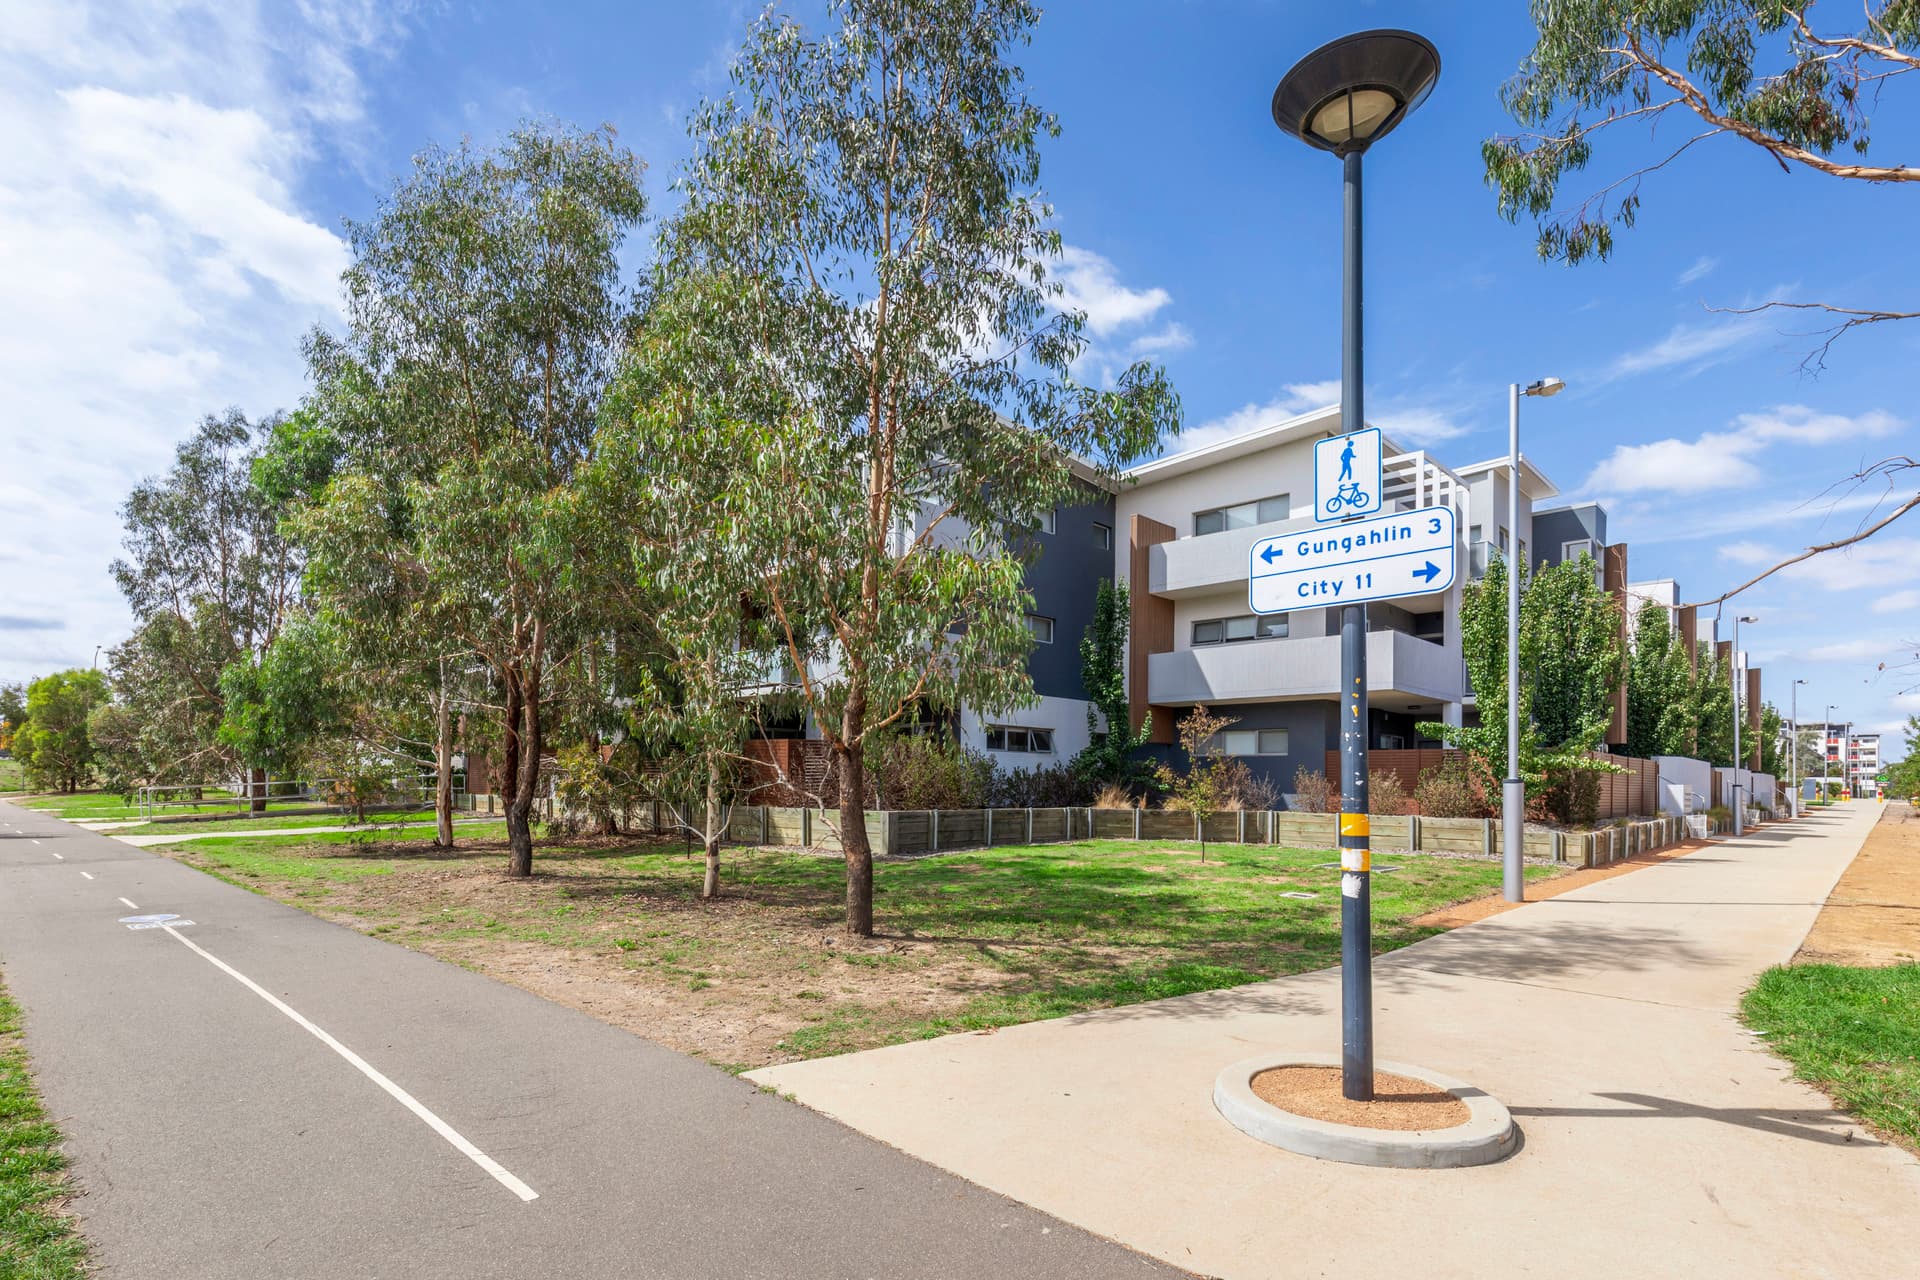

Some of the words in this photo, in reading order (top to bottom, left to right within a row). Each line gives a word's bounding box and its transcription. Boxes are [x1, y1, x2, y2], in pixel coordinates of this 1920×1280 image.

[1297, 525, 1412, 556] Gungahlin
[1428, 517, 1442, 535] 3
[1297, 579, 1344, 598] City
[1355, 573, 1372, 589] 11
